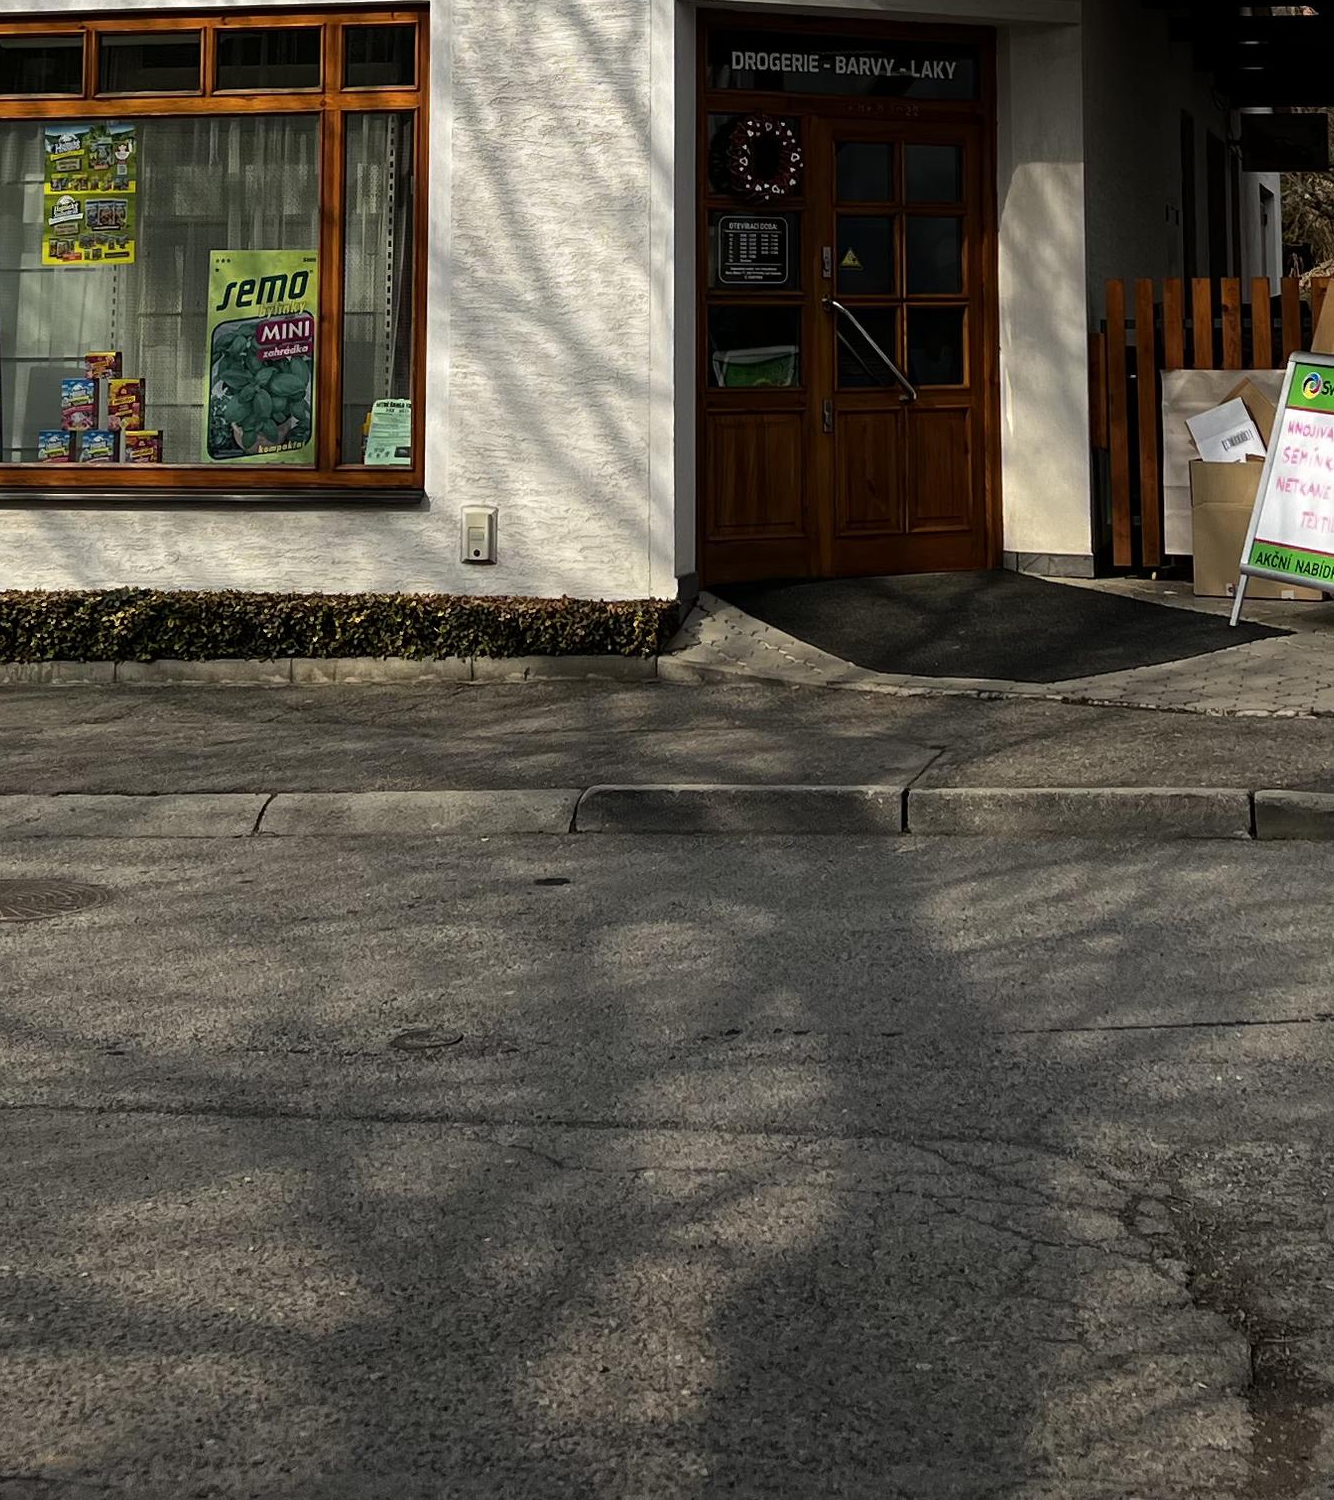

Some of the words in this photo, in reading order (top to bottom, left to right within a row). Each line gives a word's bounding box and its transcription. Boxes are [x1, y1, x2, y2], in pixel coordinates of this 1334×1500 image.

[731, 51, 820, 73] DROGERIE
[835, 56, 895, 76] BARVY
[911, 59, 957, 80] LAKY
[216, 270, 309, 312] semo
[257, 300, 306, 319] bylinky
[260, 320, 310, 342] MINI
[262, 343, 309, 359] zahrádka
[1287, 420, 1334, 442] HNOJIVA
[1255, 550, 1293, 571] AKČNÍ
